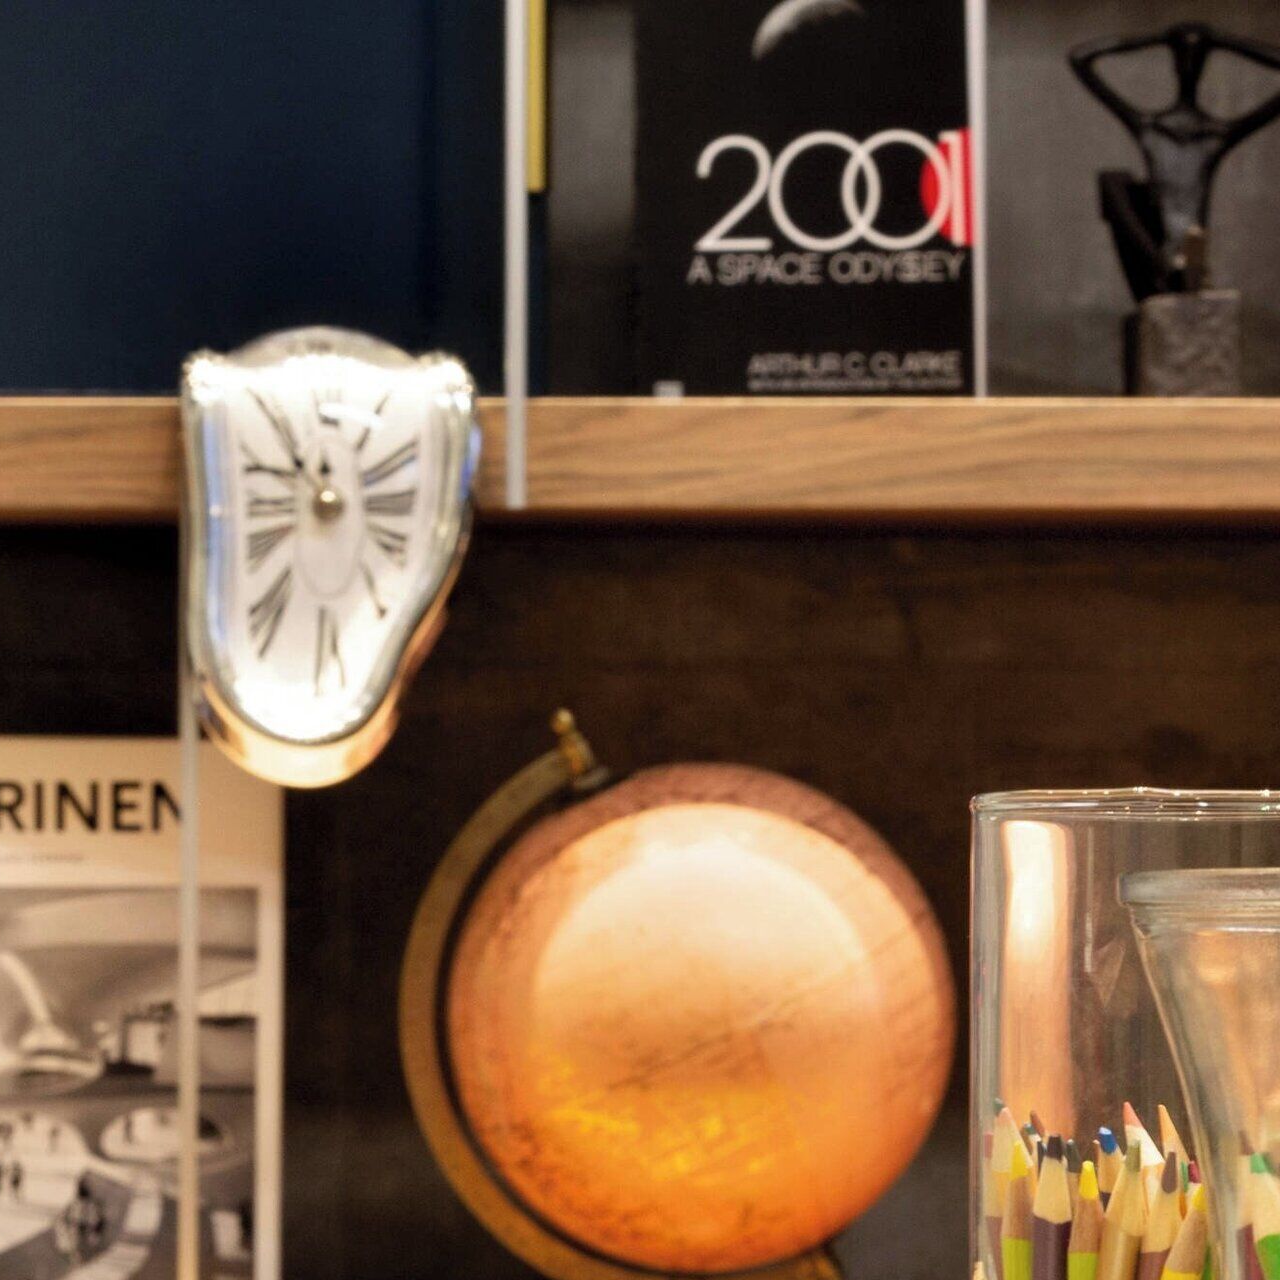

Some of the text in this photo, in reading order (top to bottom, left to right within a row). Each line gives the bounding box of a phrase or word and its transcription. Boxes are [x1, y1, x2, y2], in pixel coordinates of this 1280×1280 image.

[694, 129, 964, 252] 2001
[686, 253, 713, 285] A
[717, 251, 823, 285] SPACE
